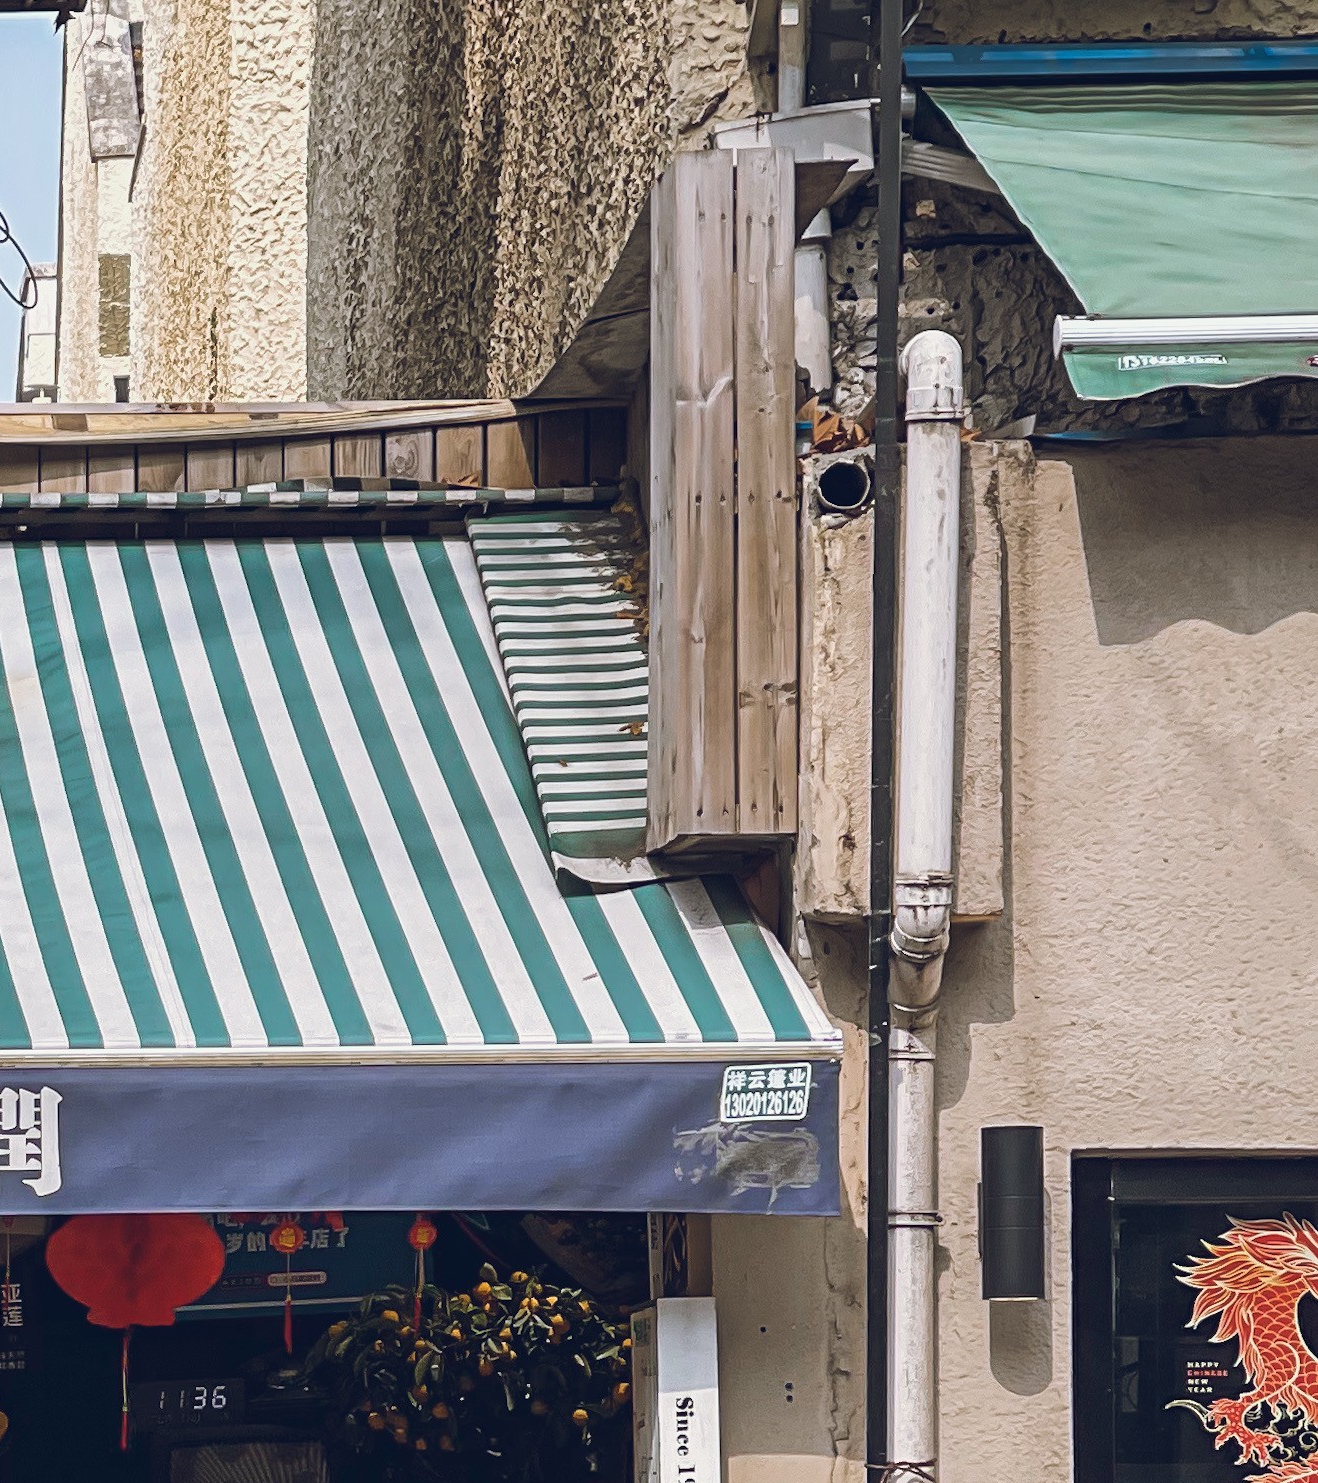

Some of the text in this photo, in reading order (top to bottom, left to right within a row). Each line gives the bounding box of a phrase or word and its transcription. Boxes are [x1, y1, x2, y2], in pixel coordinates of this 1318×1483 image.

[724, 1090, 804, 1118] 13020126126
[1187, 1369, 1228, 1377] CHINESE
[675, 1396, 694, 1457] Since
